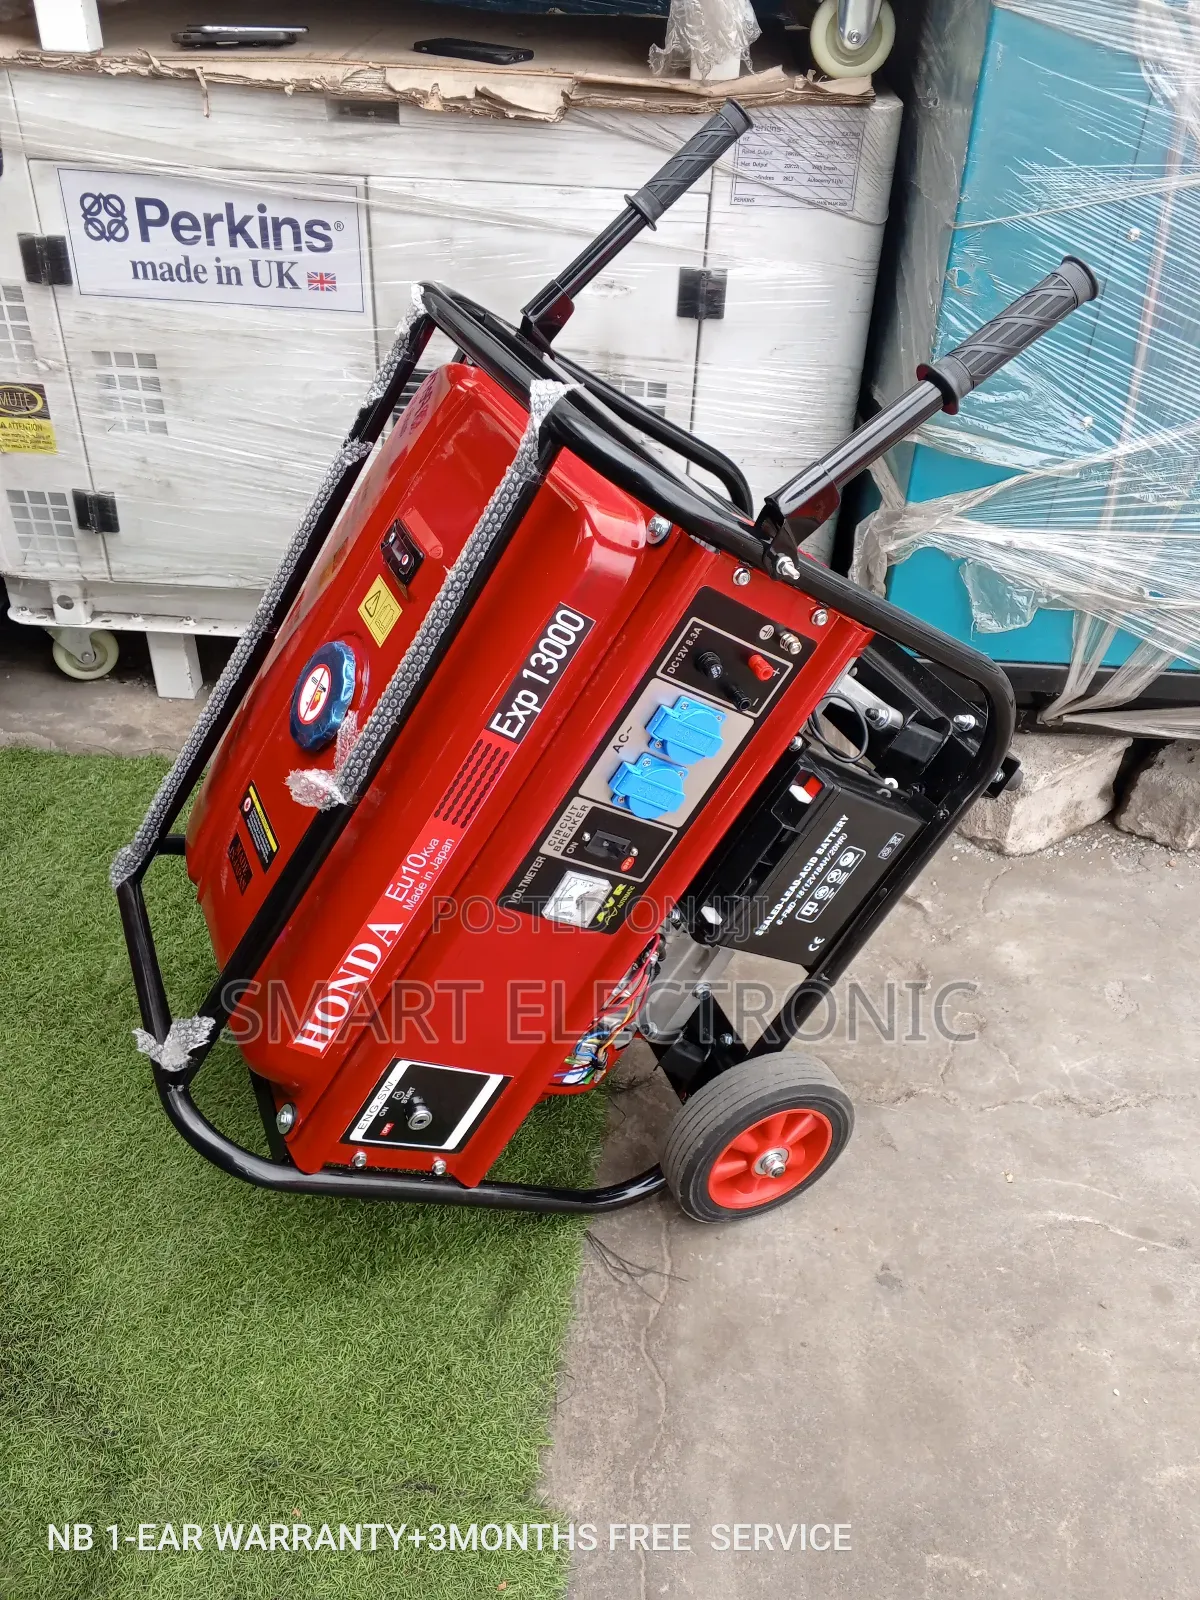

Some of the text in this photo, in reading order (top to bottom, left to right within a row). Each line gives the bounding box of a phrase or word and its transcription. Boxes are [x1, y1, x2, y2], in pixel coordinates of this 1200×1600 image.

[129, 254, 302, 291] made in UK
[8, 422, 43, 431] ATTENTION
[489, 609, 585, 739] Exp 13000
[666, 627, 703, 675] DC12V 8.3A
[547, 803, 580, 847] CIRCUIT
[553, 804, 590, 853] BREAKER
[566, 840, 579, 854] ON
[402, 837, 455, 911] Made in Japan
[508, 855, 547, 905] VOLTMETER
[754, 856, 819, 936] SEALED-LEAD-ACID
[815, 814, 850, 856] BATTERY
[292, 922, 404, 1053] HONDA
[378, 1106, 390, 1117] ON
[401, 1086, 416, 1104] START
[382, 1122, 393, 1135] OFF
